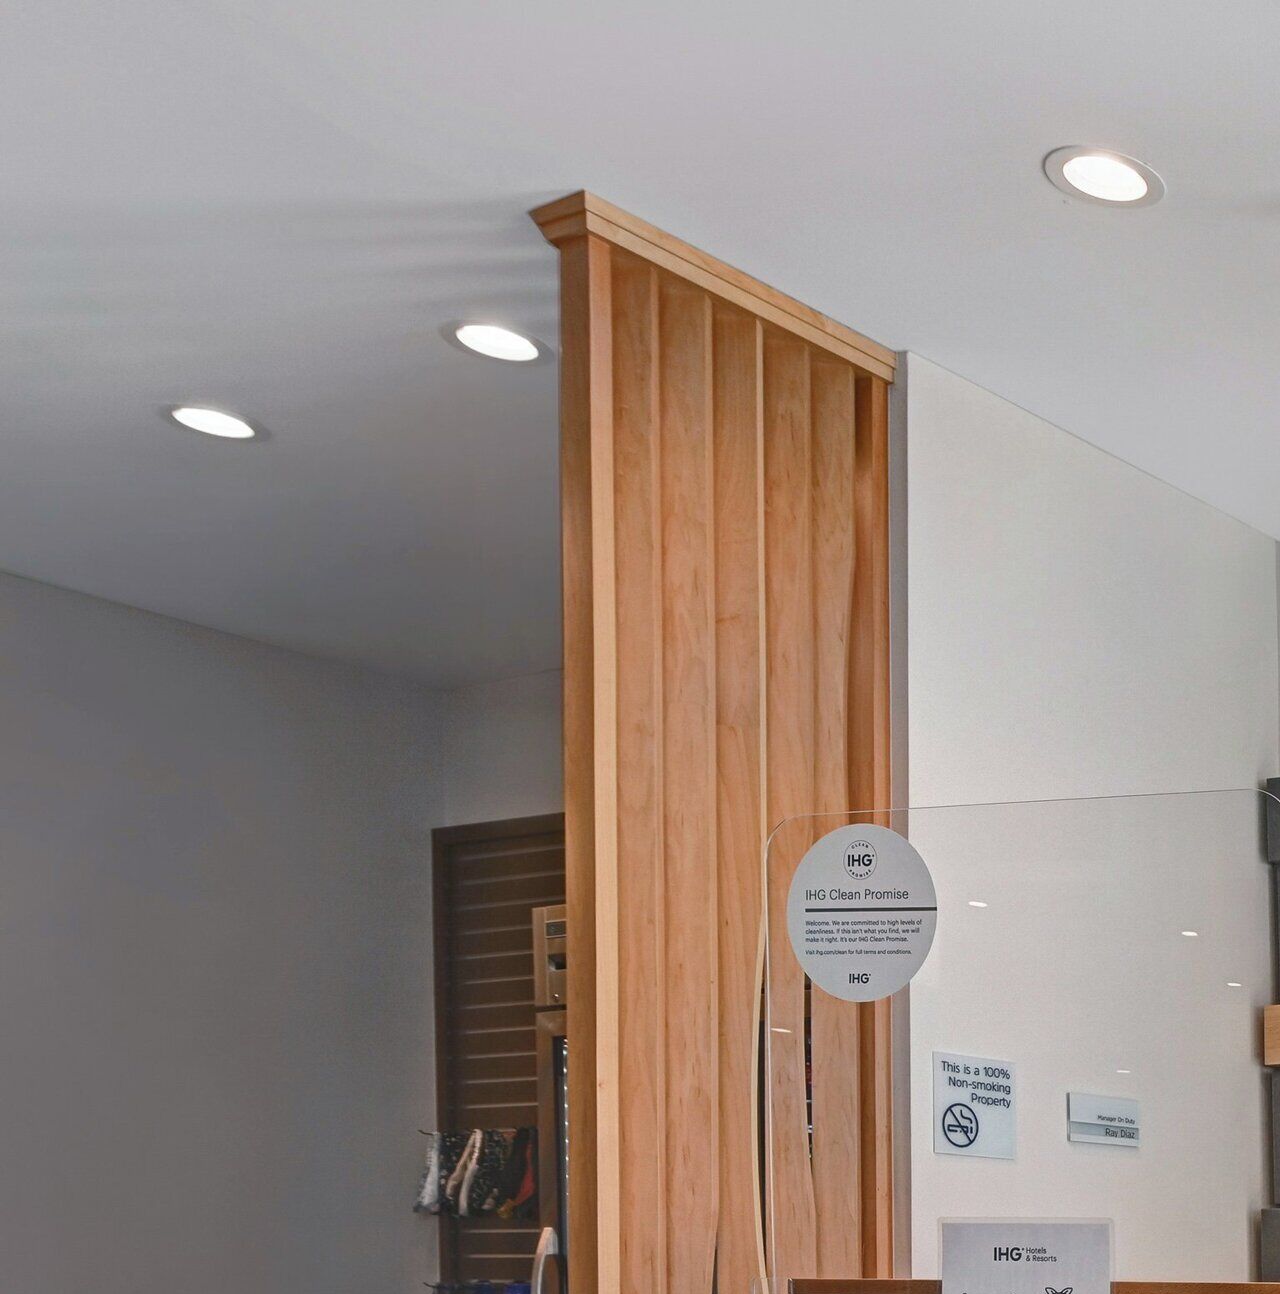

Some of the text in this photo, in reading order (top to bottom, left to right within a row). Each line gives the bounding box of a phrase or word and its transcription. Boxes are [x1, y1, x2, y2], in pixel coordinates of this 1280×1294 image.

[848, 854, 872, 866] IHG
[805, 888, 909, 901] IHG Clean Promise
[849, 973, 870, 984] IHG
[942, 1061, 960, 1073] This
[964, 1064, 970, 1075] is
[983, 1067, 1010, 1079] 100%
[949, 1077, 1011, 1094] Non-smoking
[971, 1094, 1011, 1108] Property
[1106, 1128, 1135, 1139] Ray Diaz
[994, 1247, 1022, 1261] IHG
